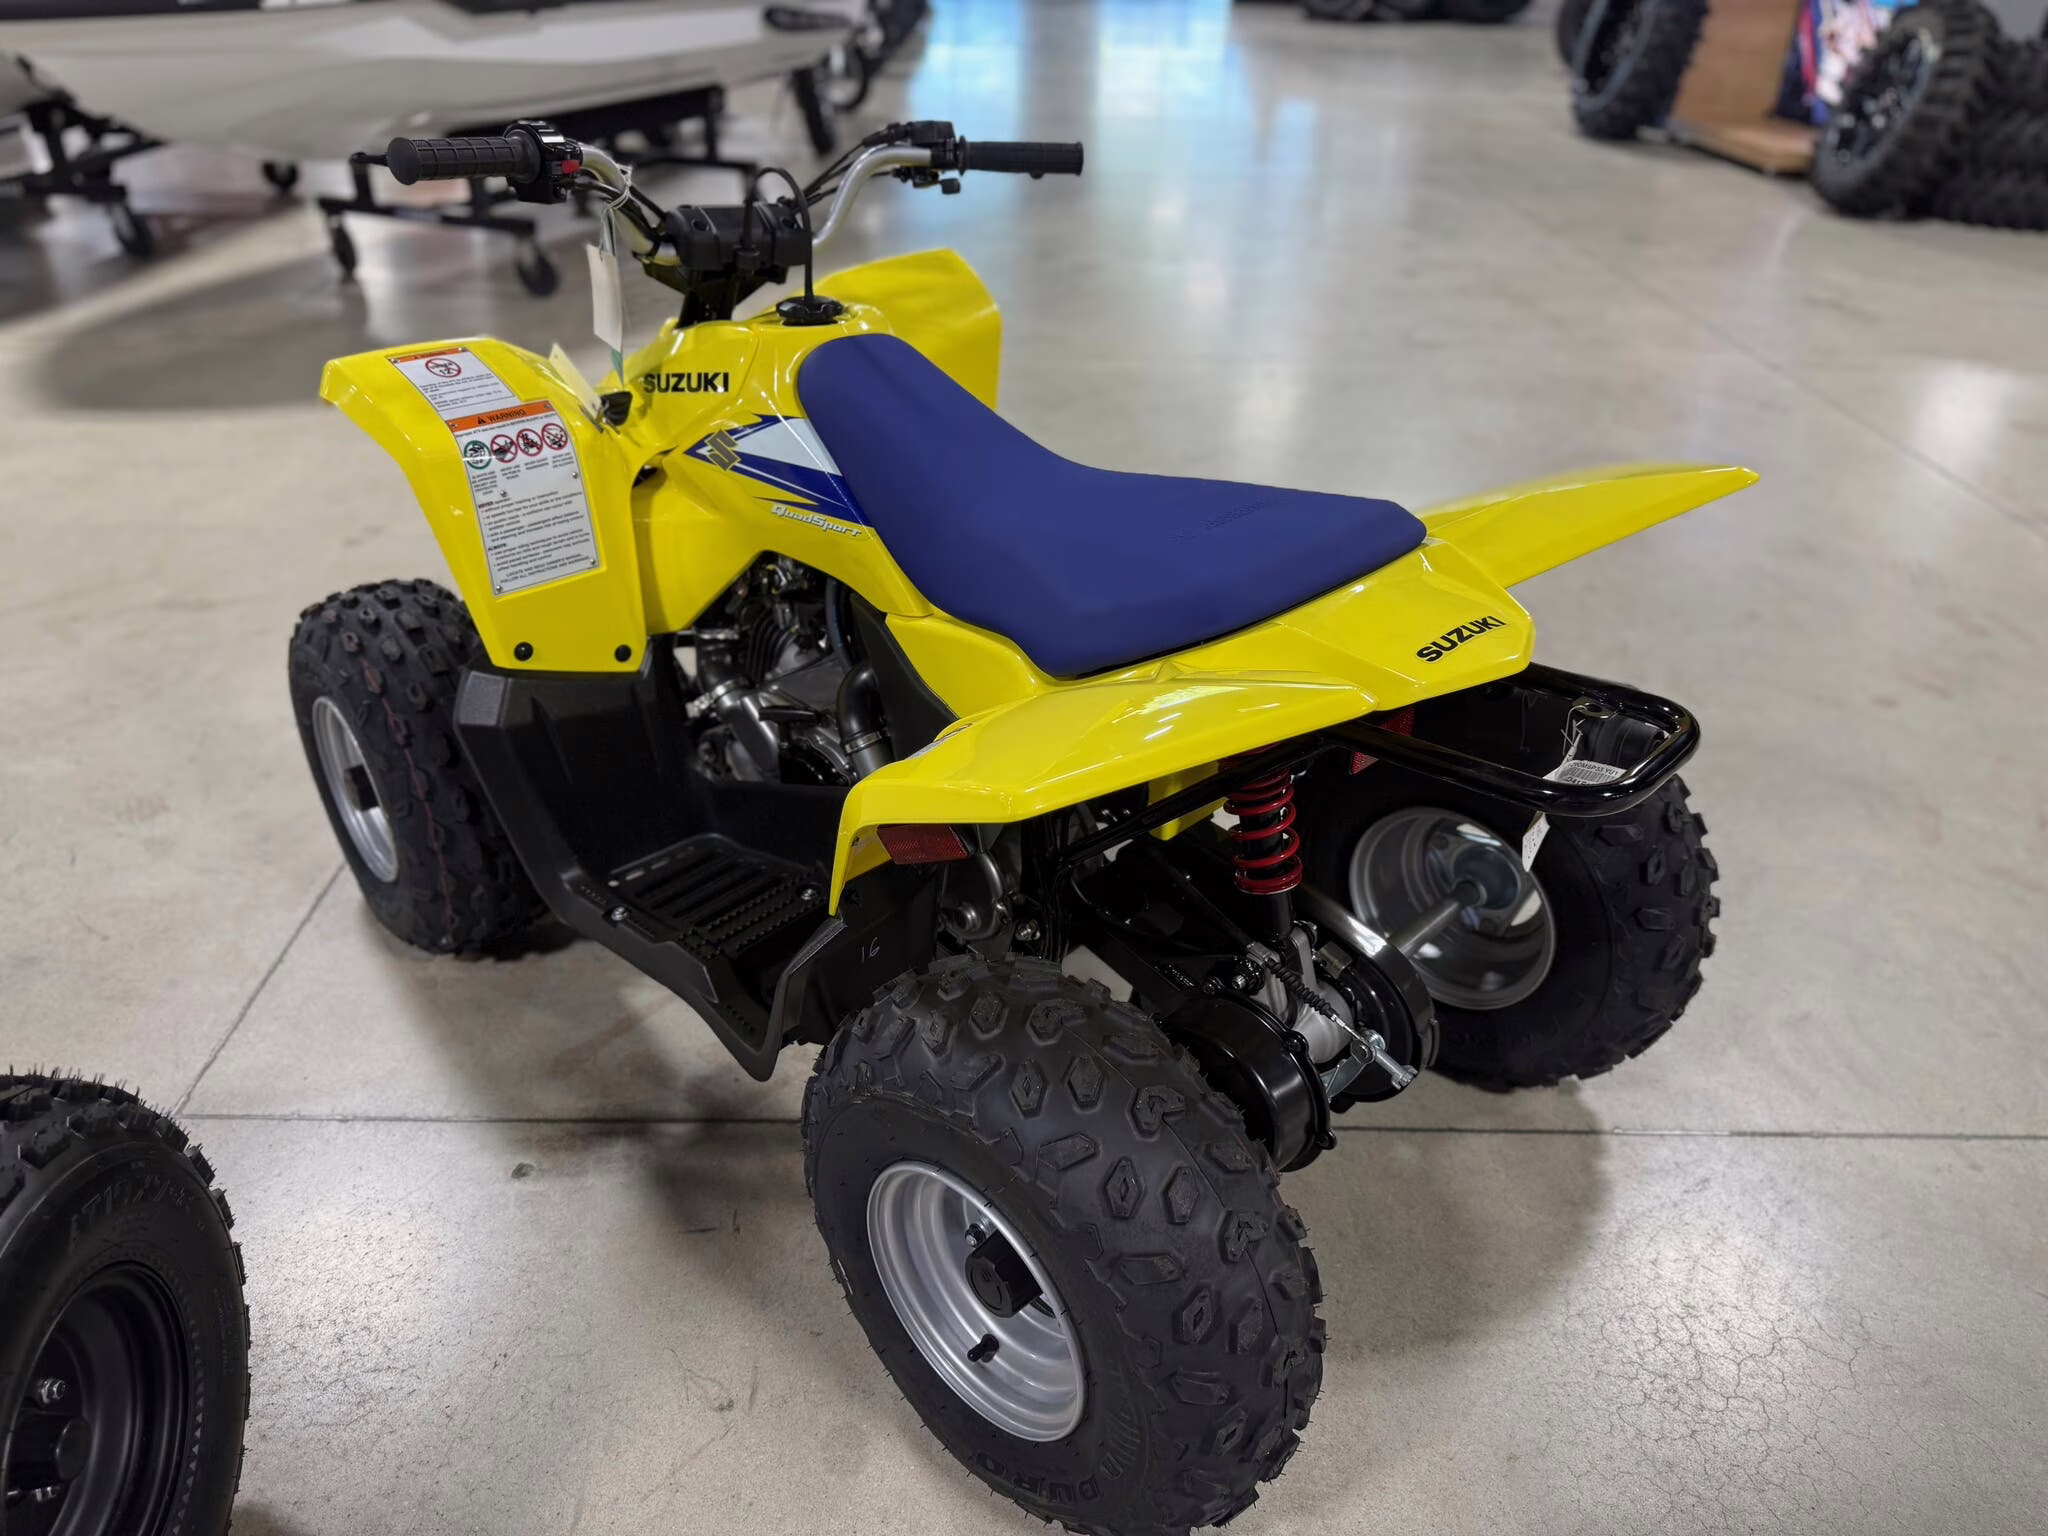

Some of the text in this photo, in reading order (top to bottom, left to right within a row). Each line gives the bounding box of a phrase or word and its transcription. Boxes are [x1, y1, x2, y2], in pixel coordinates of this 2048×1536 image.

[643, 372, 729, 393] SUZUKI
[487, 409, 527, 422] WARNING
[771, 503, 862, 538] QuadSport
[1416, 615, 1507, 662] SUZUKI
